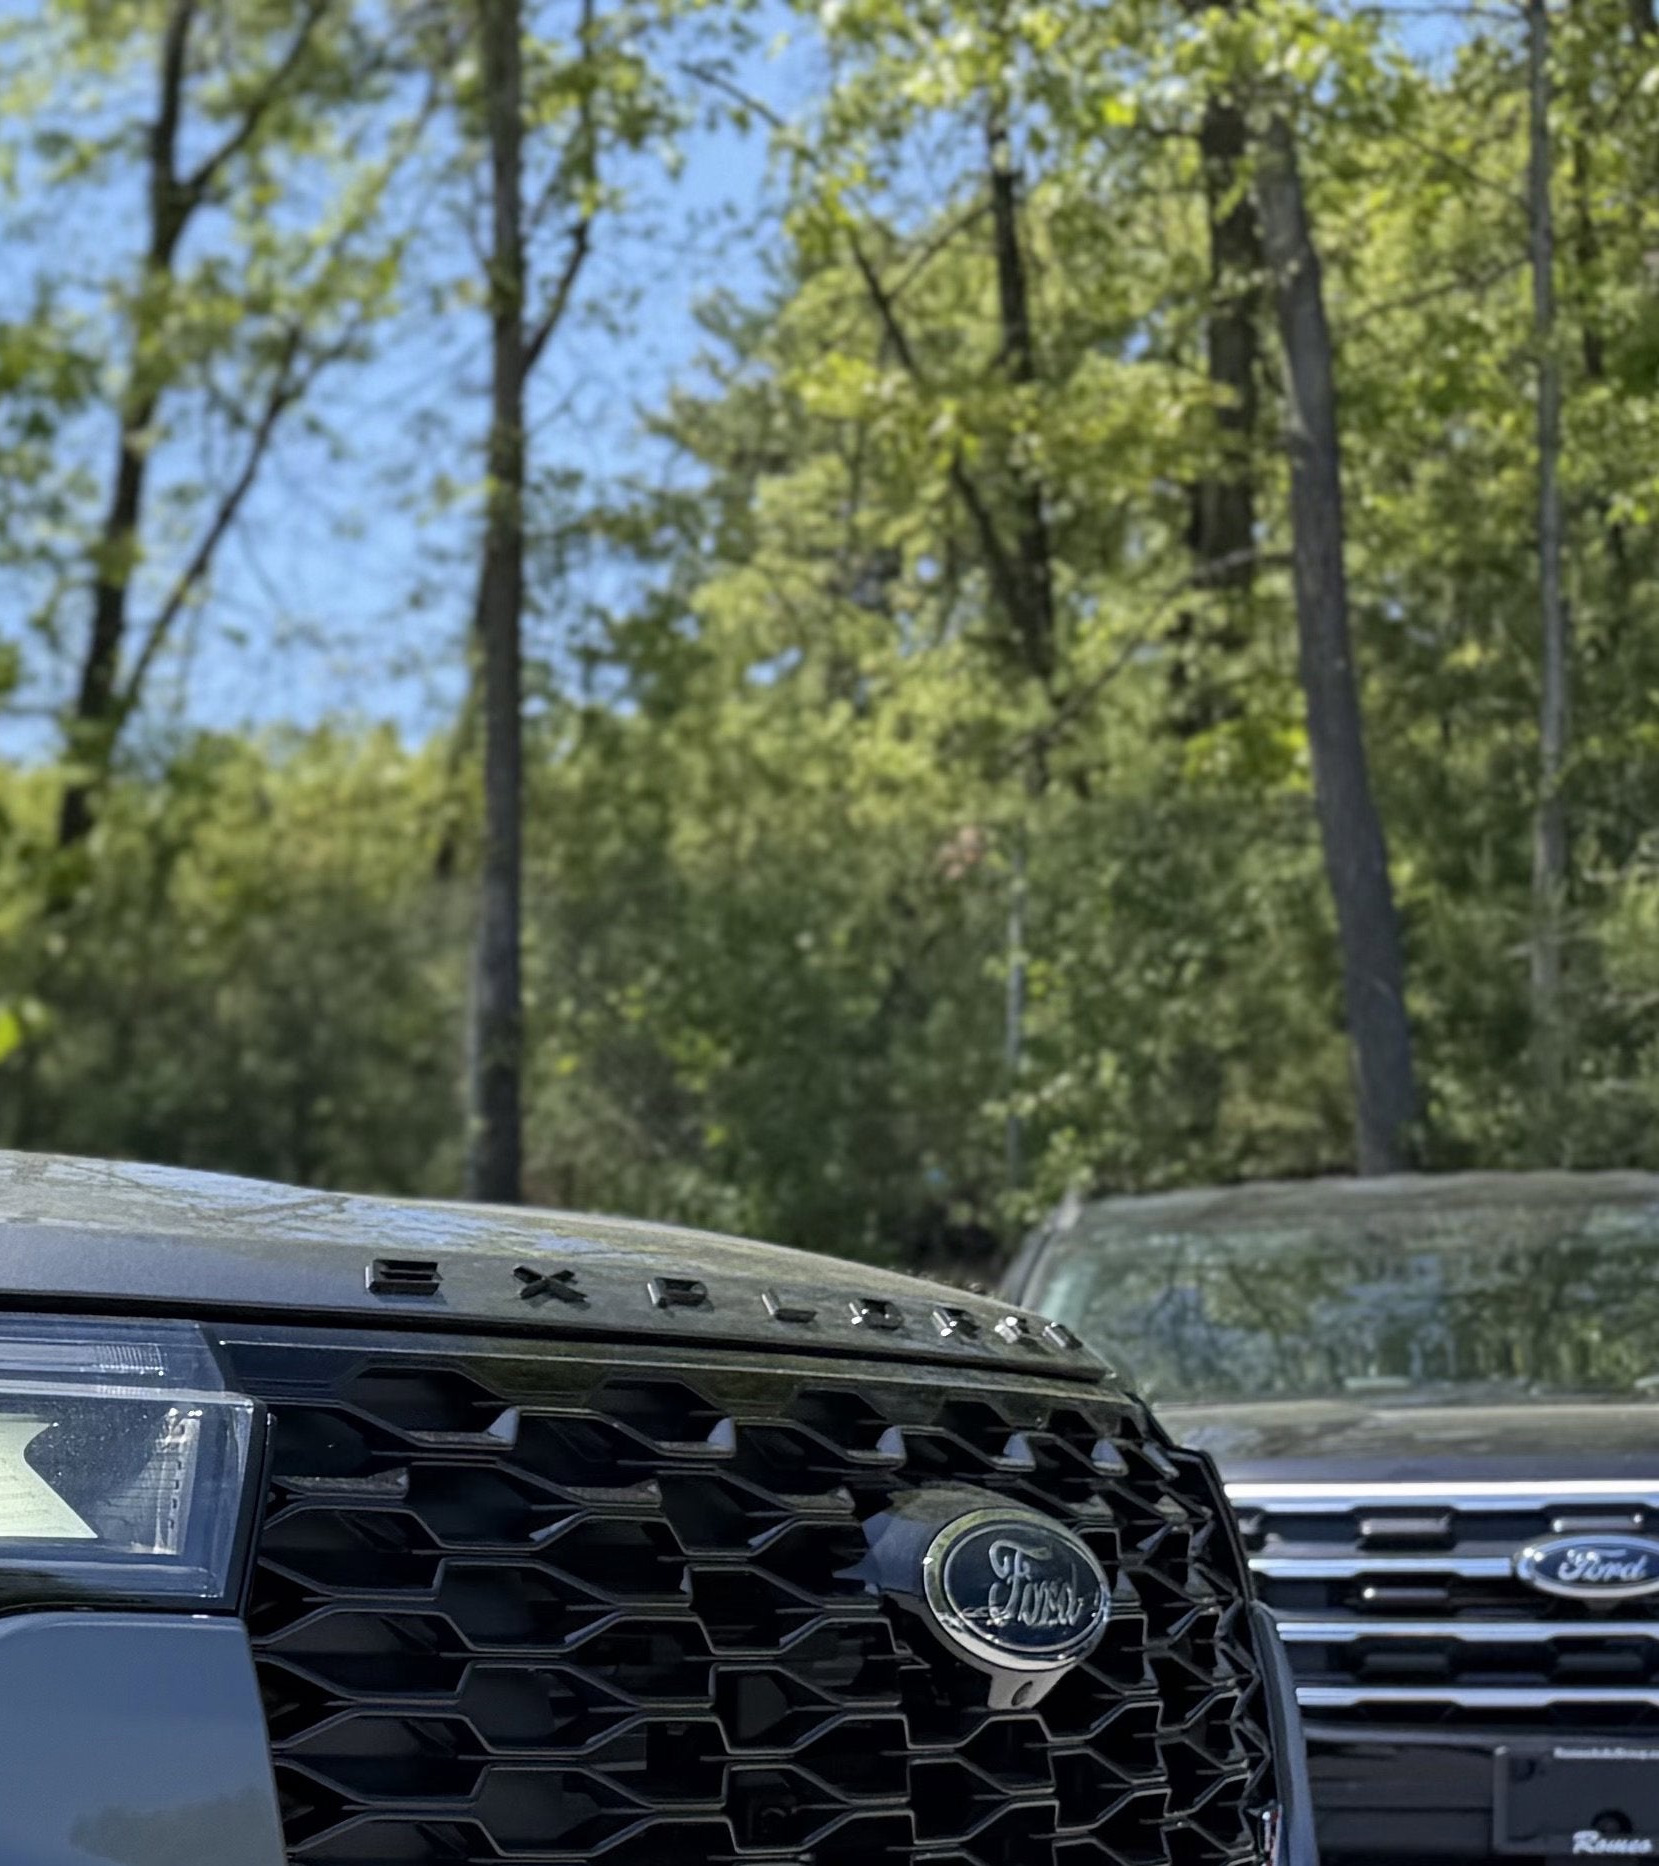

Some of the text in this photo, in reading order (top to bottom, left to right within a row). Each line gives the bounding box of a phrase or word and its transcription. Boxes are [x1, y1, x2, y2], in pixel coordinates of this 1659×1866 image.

[962, 1539, 1083, 1627] Ford
[1558, 1547, 1648, 1583] Ford
[1572, 1829, 1653, 1856] Romeo
